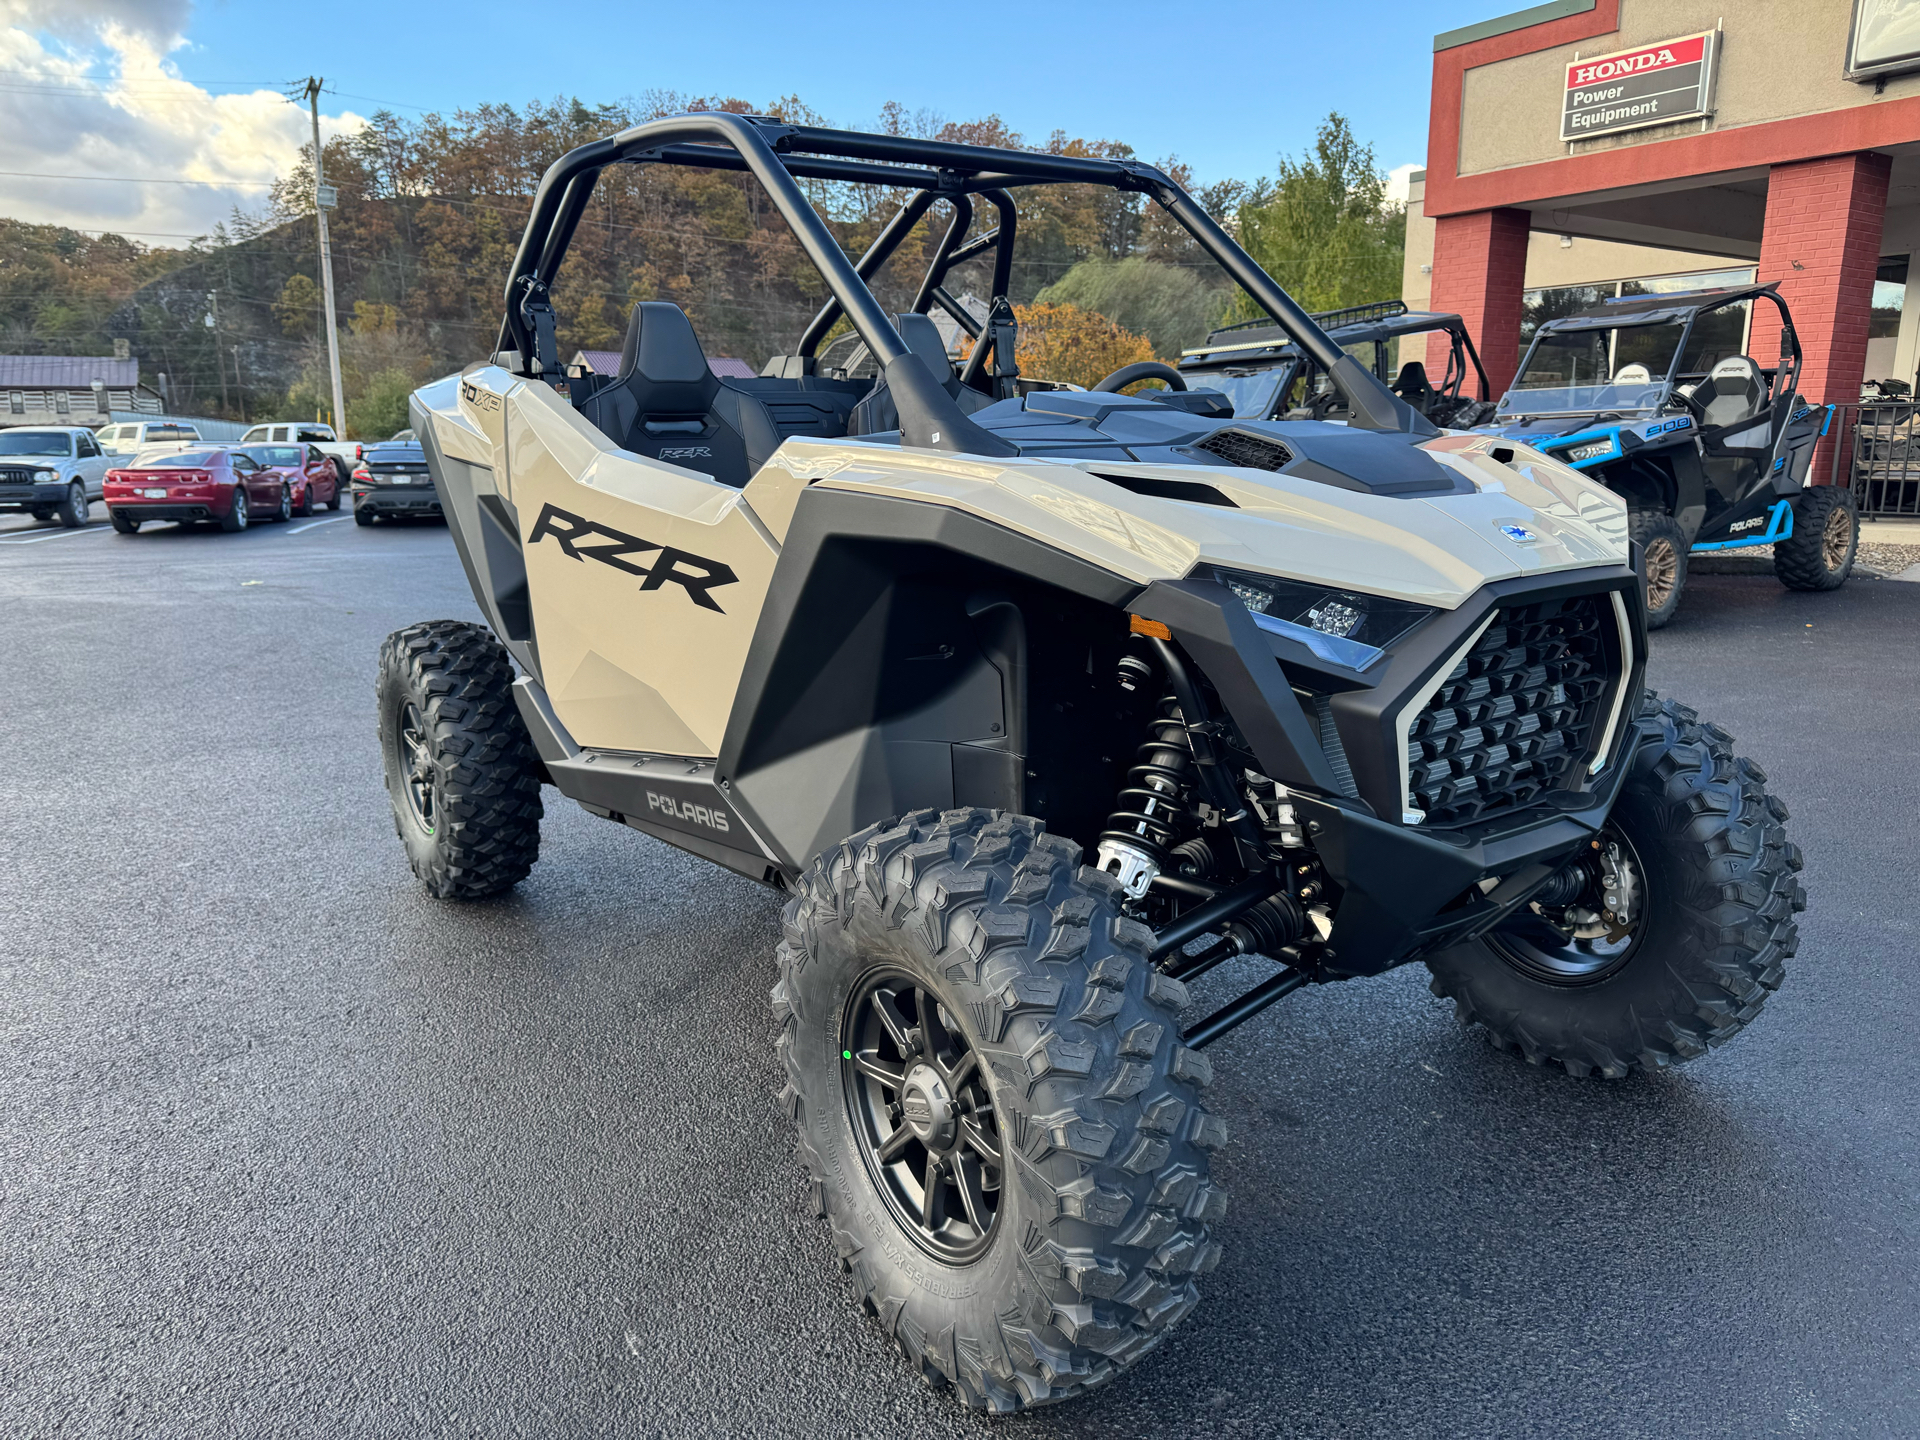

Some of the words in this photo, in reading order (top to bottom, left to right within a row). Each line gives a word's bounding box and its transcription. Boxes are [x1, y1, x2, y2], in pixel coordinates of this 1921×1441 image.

[1575, 49, 1676, 84] HONDA
[1573, 86, 1624, 106] Power
[1571, 99, 1658, 128] Equipment
[474, 389, 502, 412] XP
[658, 446, 712, 460] RZR
[1729, 516, 1764, 533] POLARIS
[527, 502, 740, 615] RZR
[646, 790, 729, 832] POLARIS
